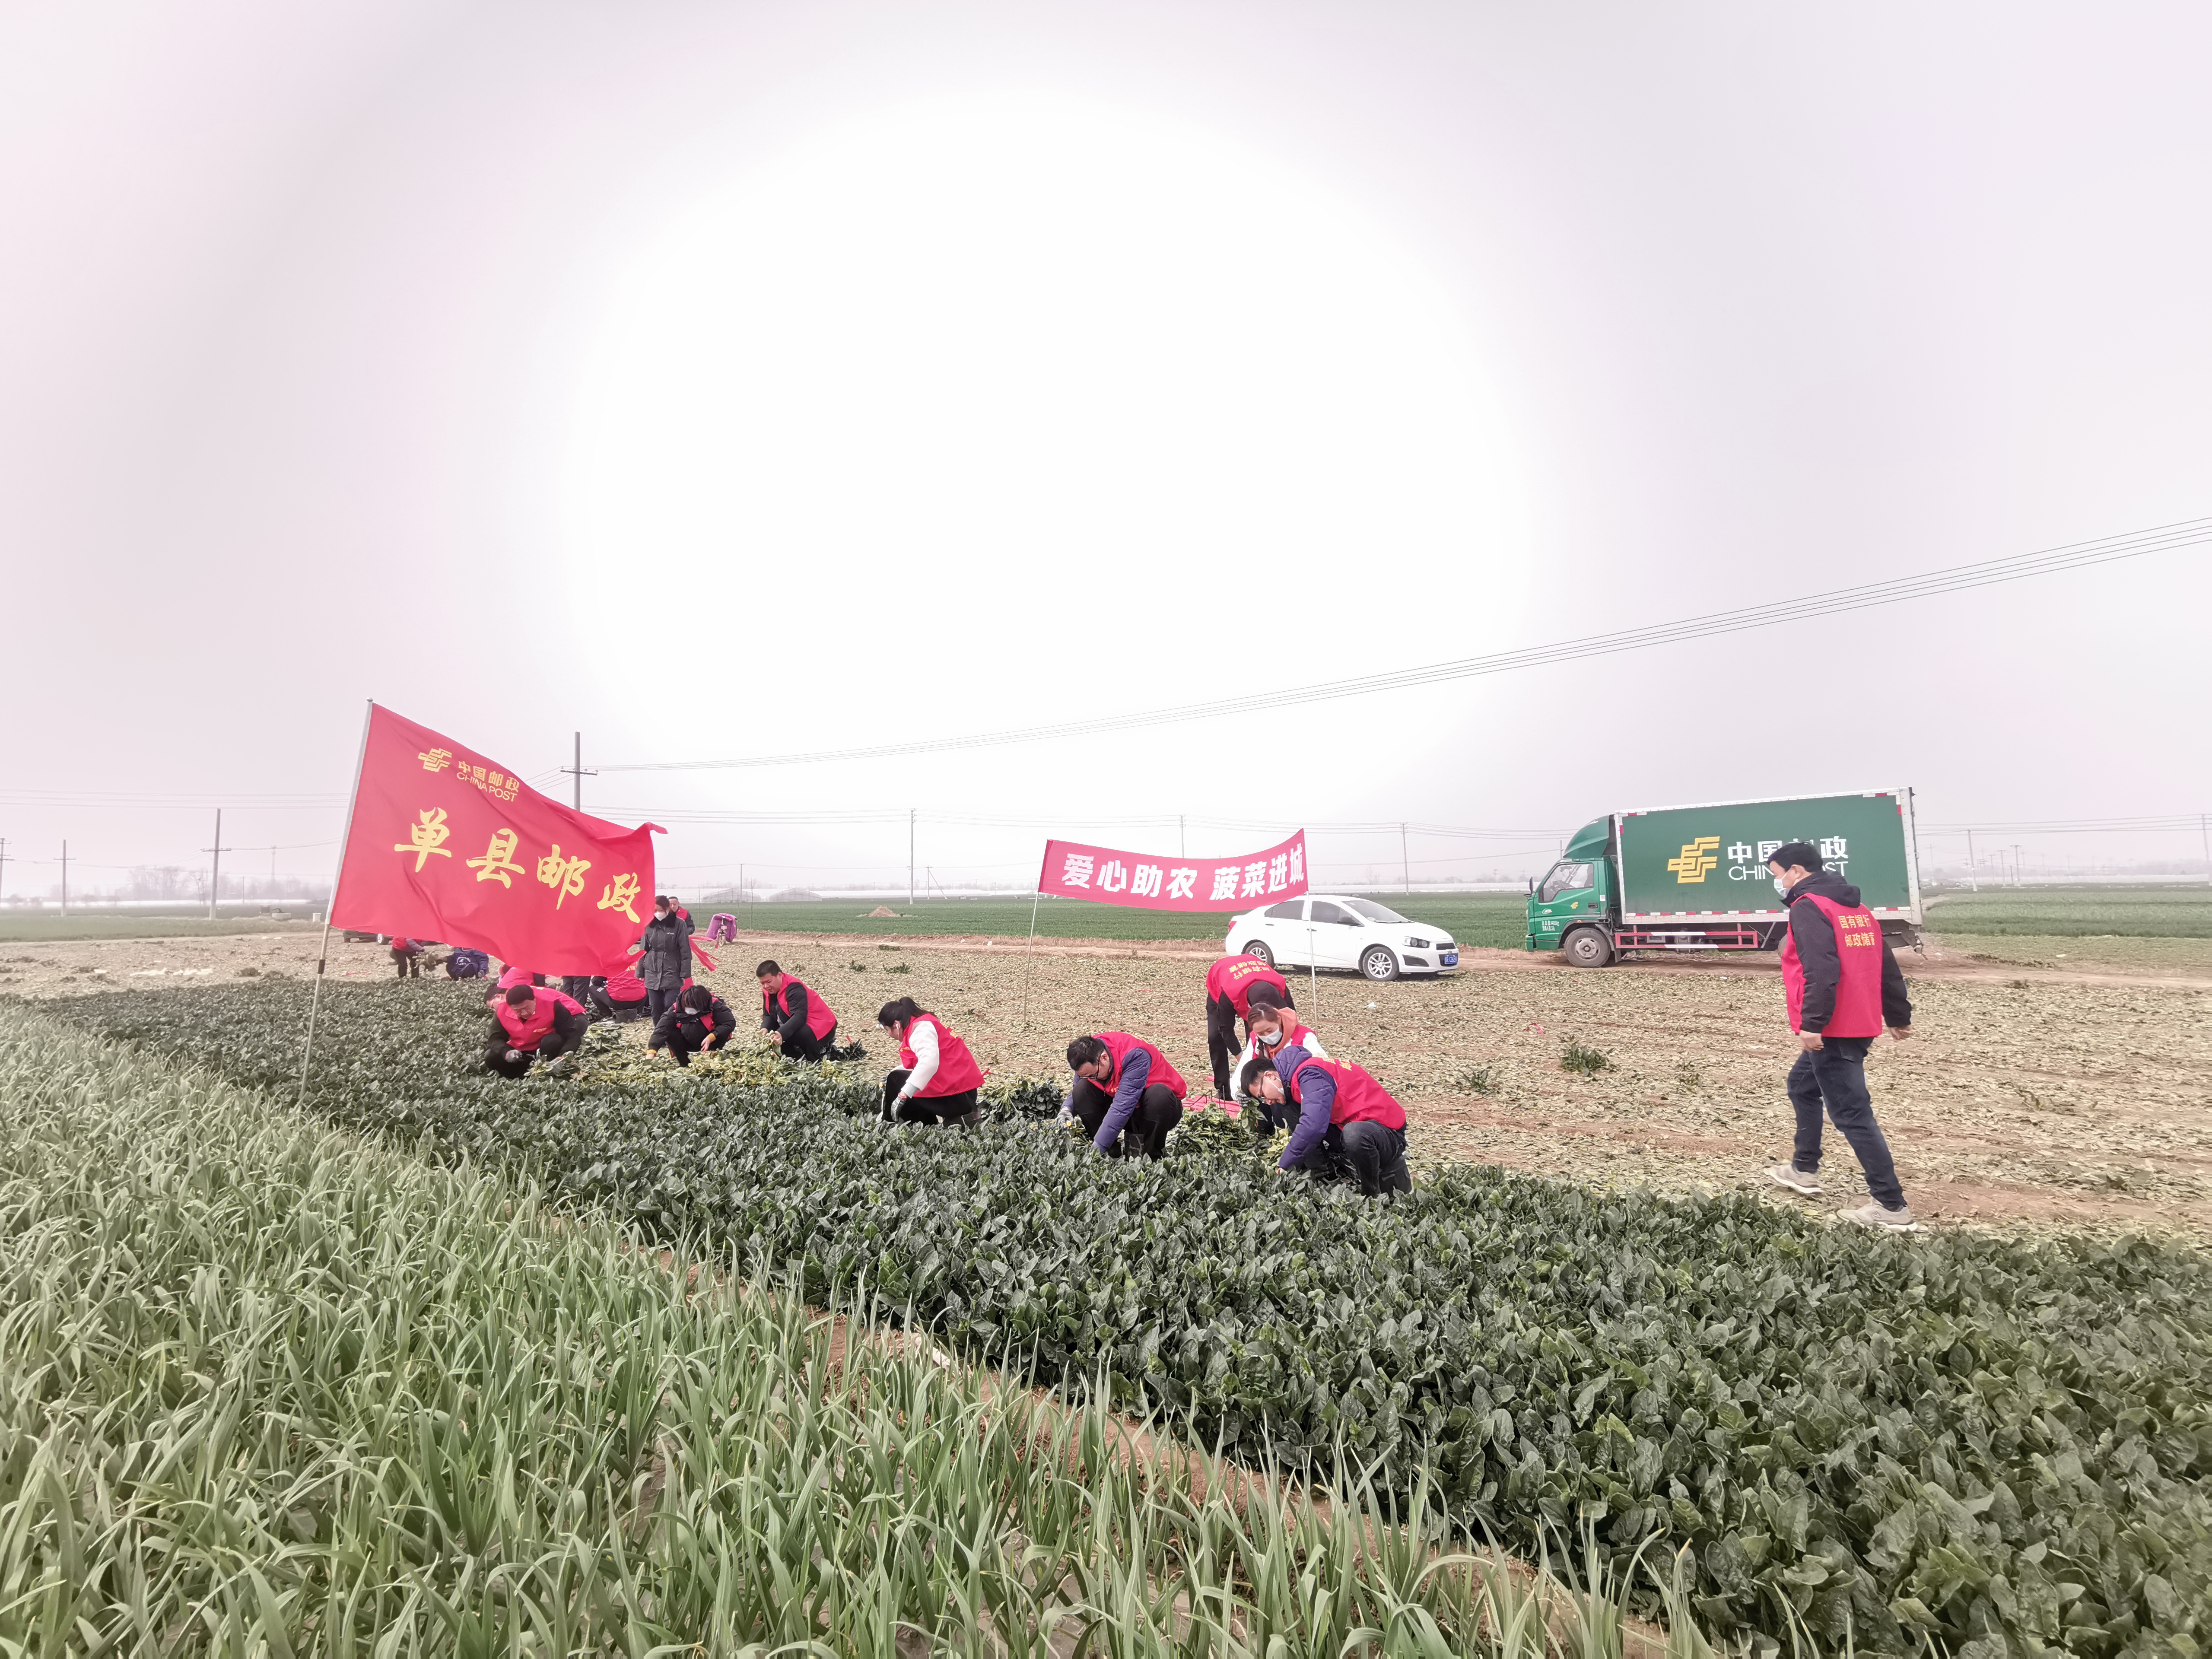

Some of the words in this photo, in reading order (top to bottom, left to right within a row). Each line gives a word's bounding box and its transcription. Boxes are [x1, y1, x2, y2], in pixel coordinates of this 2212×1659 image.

[457, 772, 487, 792] CHINA
[489, 785, 518, 802] POST
[458, 760, 520, 793] 中国邮政
[394, 807, 641, 923] 单县邮政
[1727, 836, 1849, 864] 中国政
[1062, 853, 1198, 899] 爱心助农
[1209, 843, 1304, 900] 菠菜进城
[1728, 864, 1775, 880] CHIN
[1837, 914, 1872, 929] 国有银行
